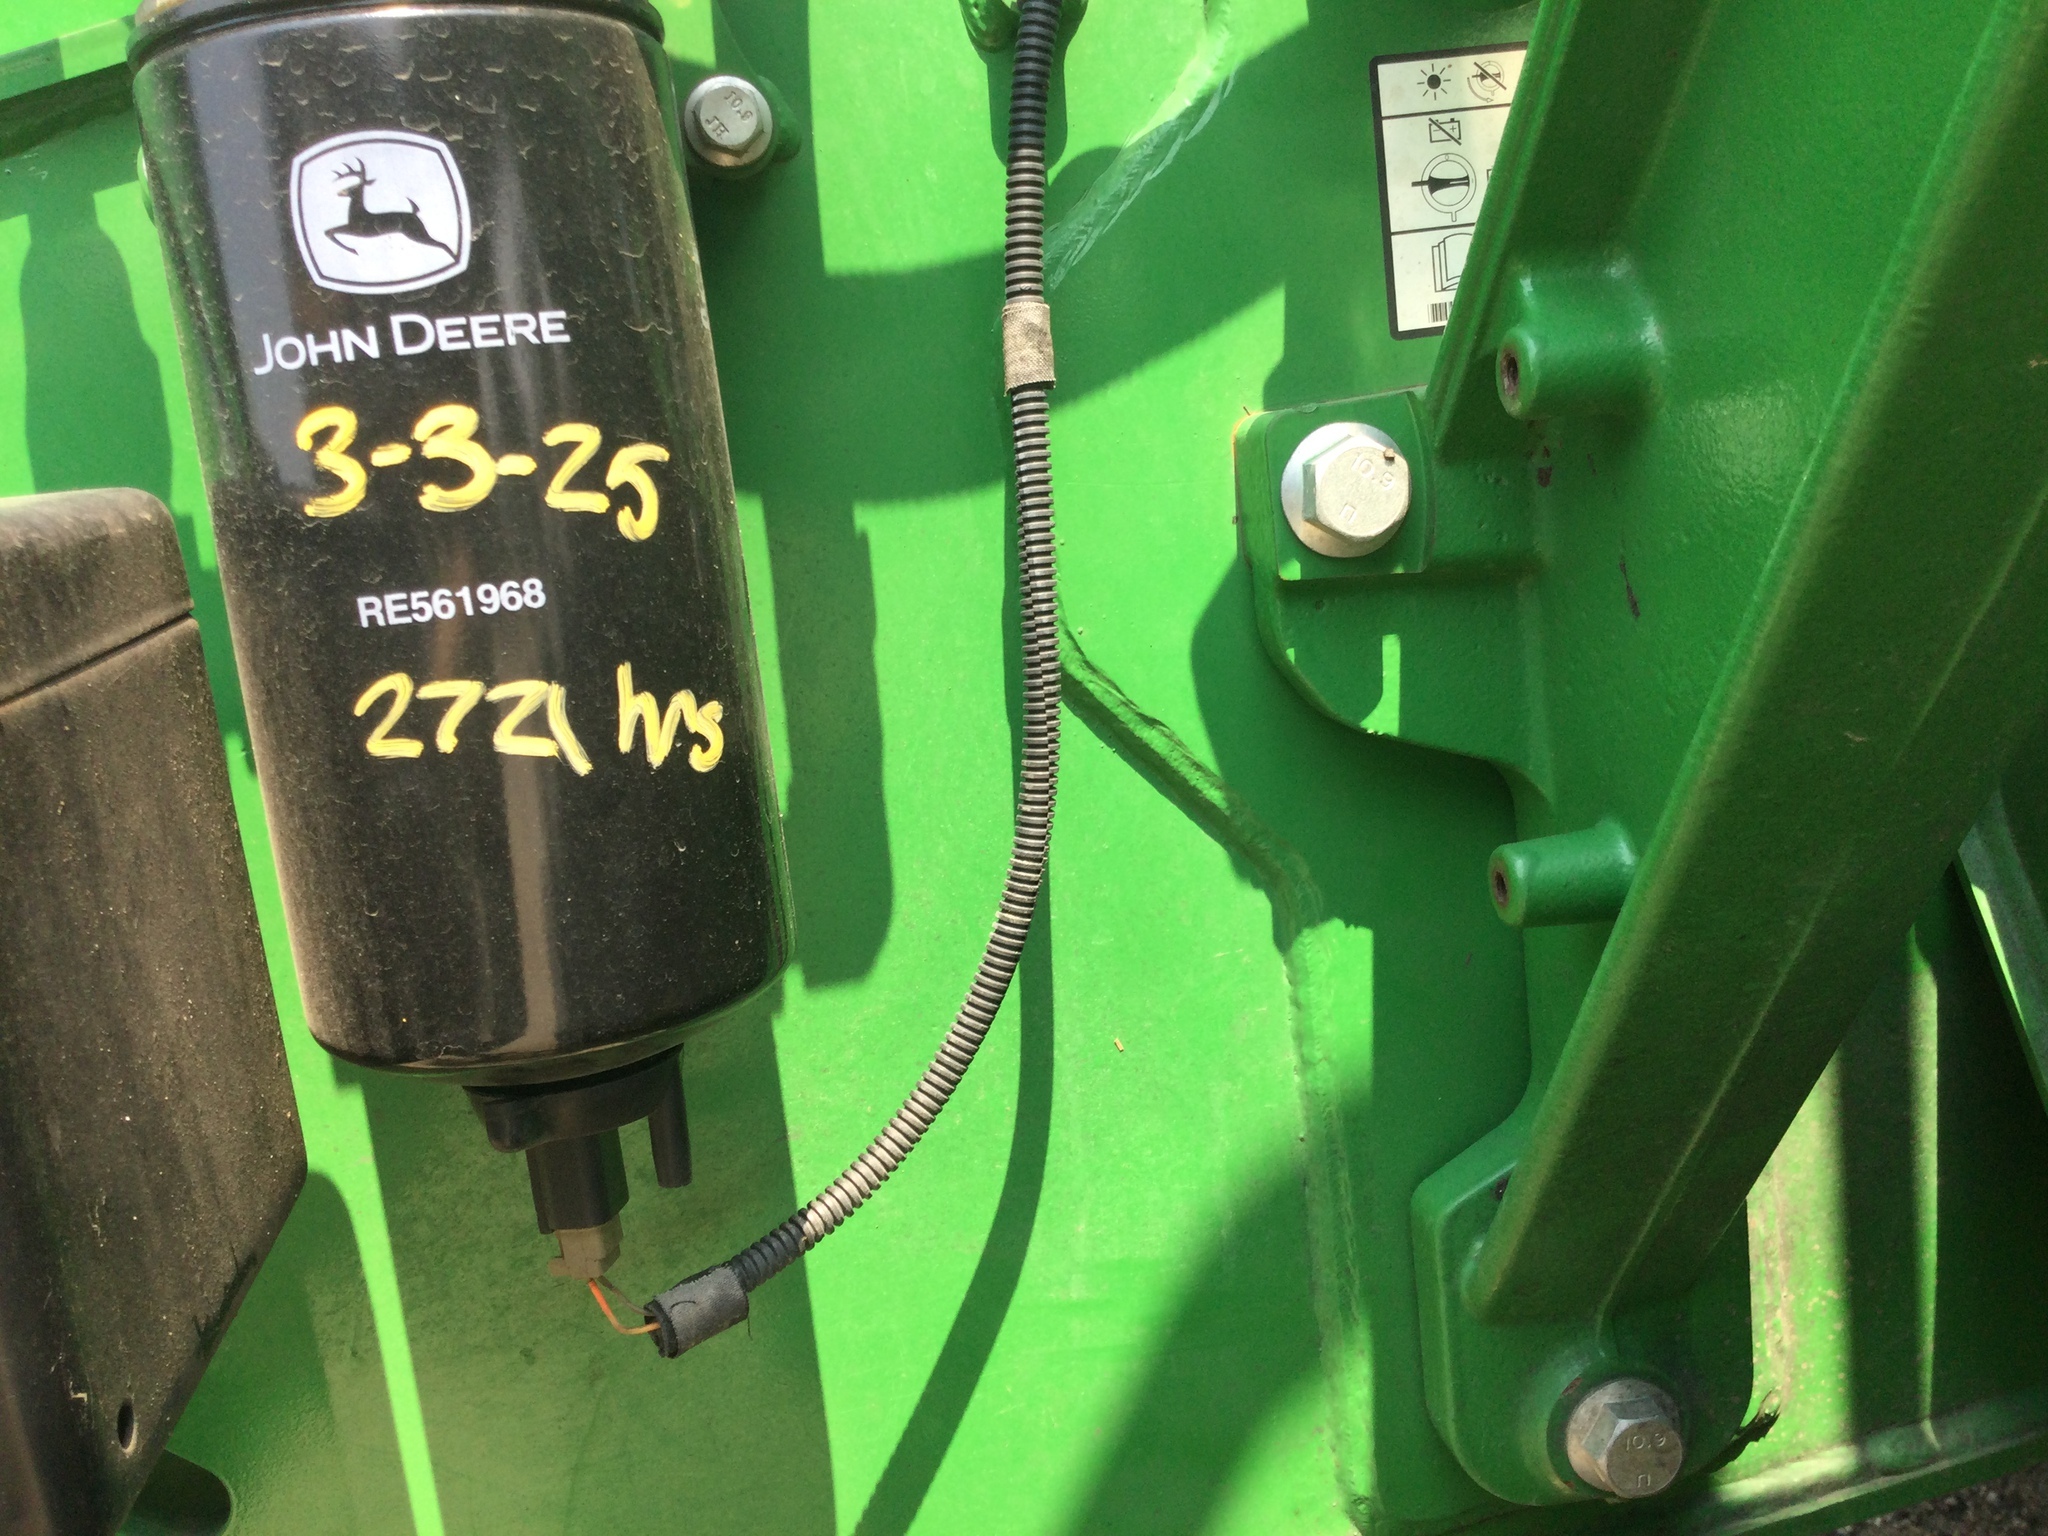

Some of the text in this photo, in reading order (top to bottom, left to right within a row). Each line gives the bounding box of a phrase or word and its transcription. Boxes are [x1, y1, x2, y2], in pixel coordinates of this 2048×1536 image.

[253, 310, 571, 375] JOHN DEERE
[296, 404, 670, 542] 3-3-25
[356, 578, 547, 628] RE561968
[354, 661, 724, 777] 2721 hrs
